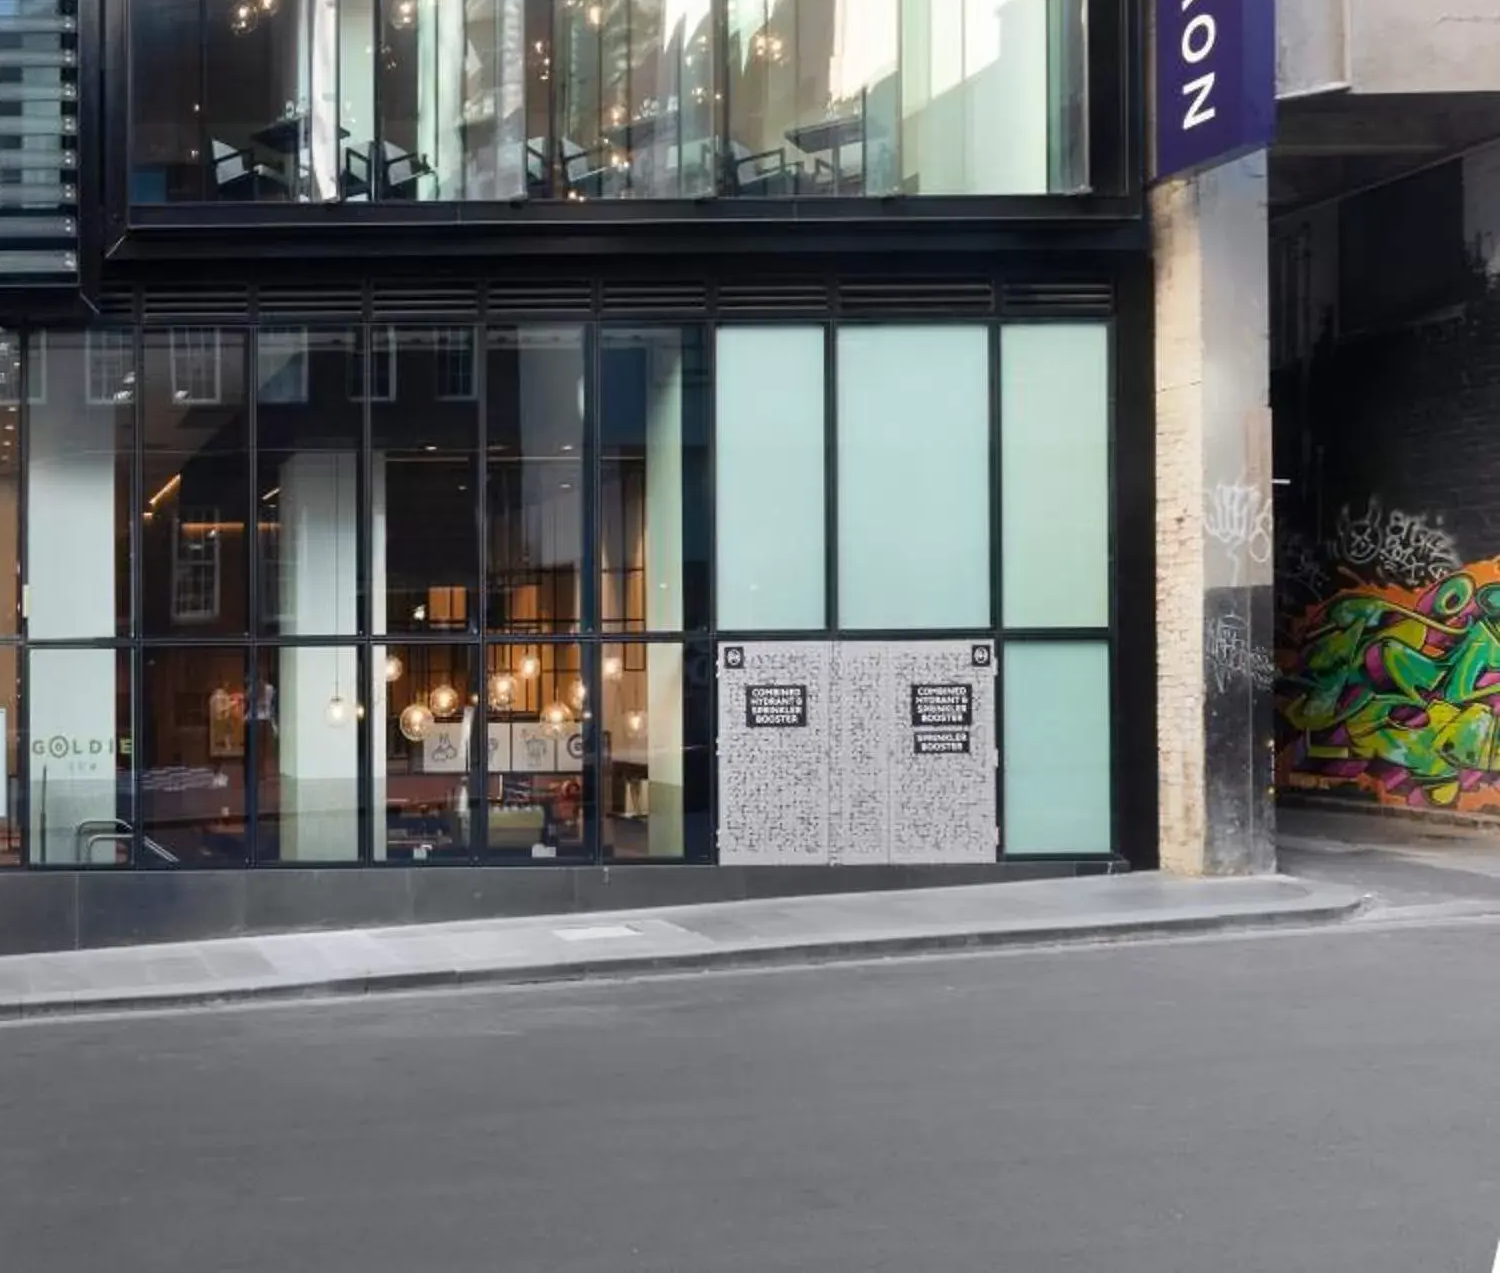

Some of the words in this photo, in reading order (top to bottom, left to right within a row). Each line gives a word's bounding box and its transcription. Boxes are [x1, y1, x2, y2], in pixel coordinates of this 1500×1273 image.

[755, 715, 798, 724] BOOSTER
[921, 714, 963, 723] BOOSTER
[32, 735, 132, 759] GOLDIE
[921, 742, 963, 751] BOOSTER
